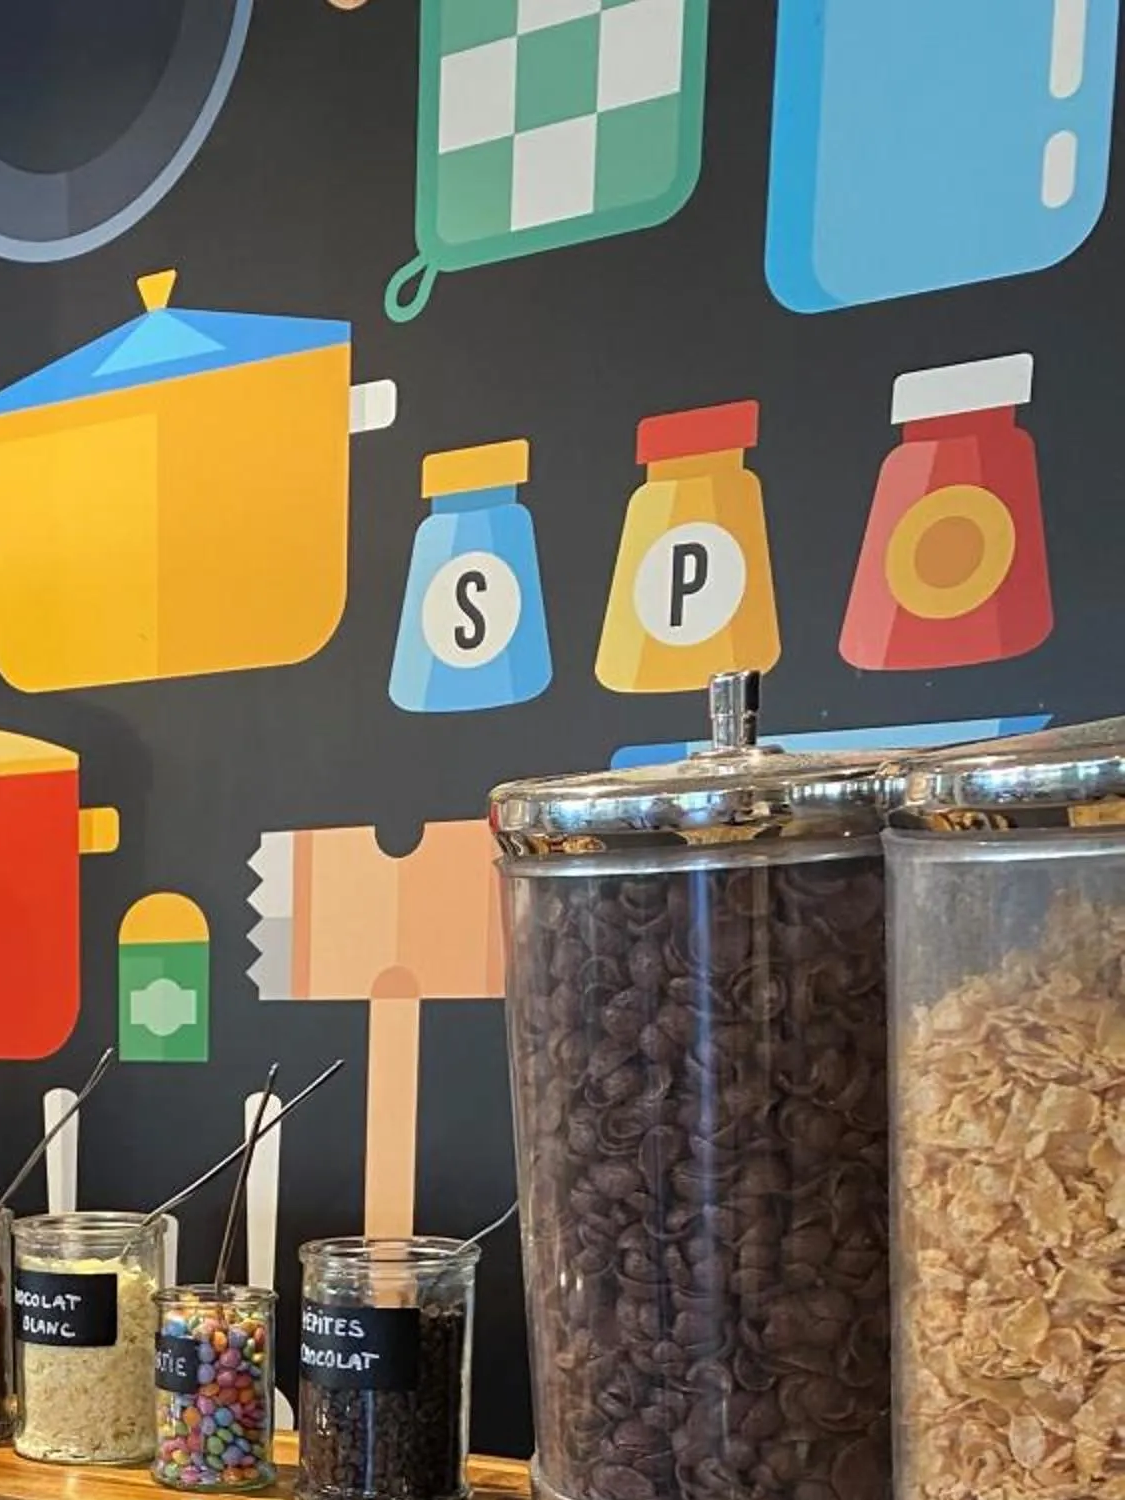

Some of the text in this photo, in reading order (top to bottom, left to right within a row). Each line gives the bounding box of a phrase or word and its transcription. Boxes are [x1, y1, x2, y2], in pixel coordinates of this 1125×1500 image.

[454, 570, 487, 649] S
[670, 542, 708, 627] P
[22, 1315, 76, 1338] BLANC
